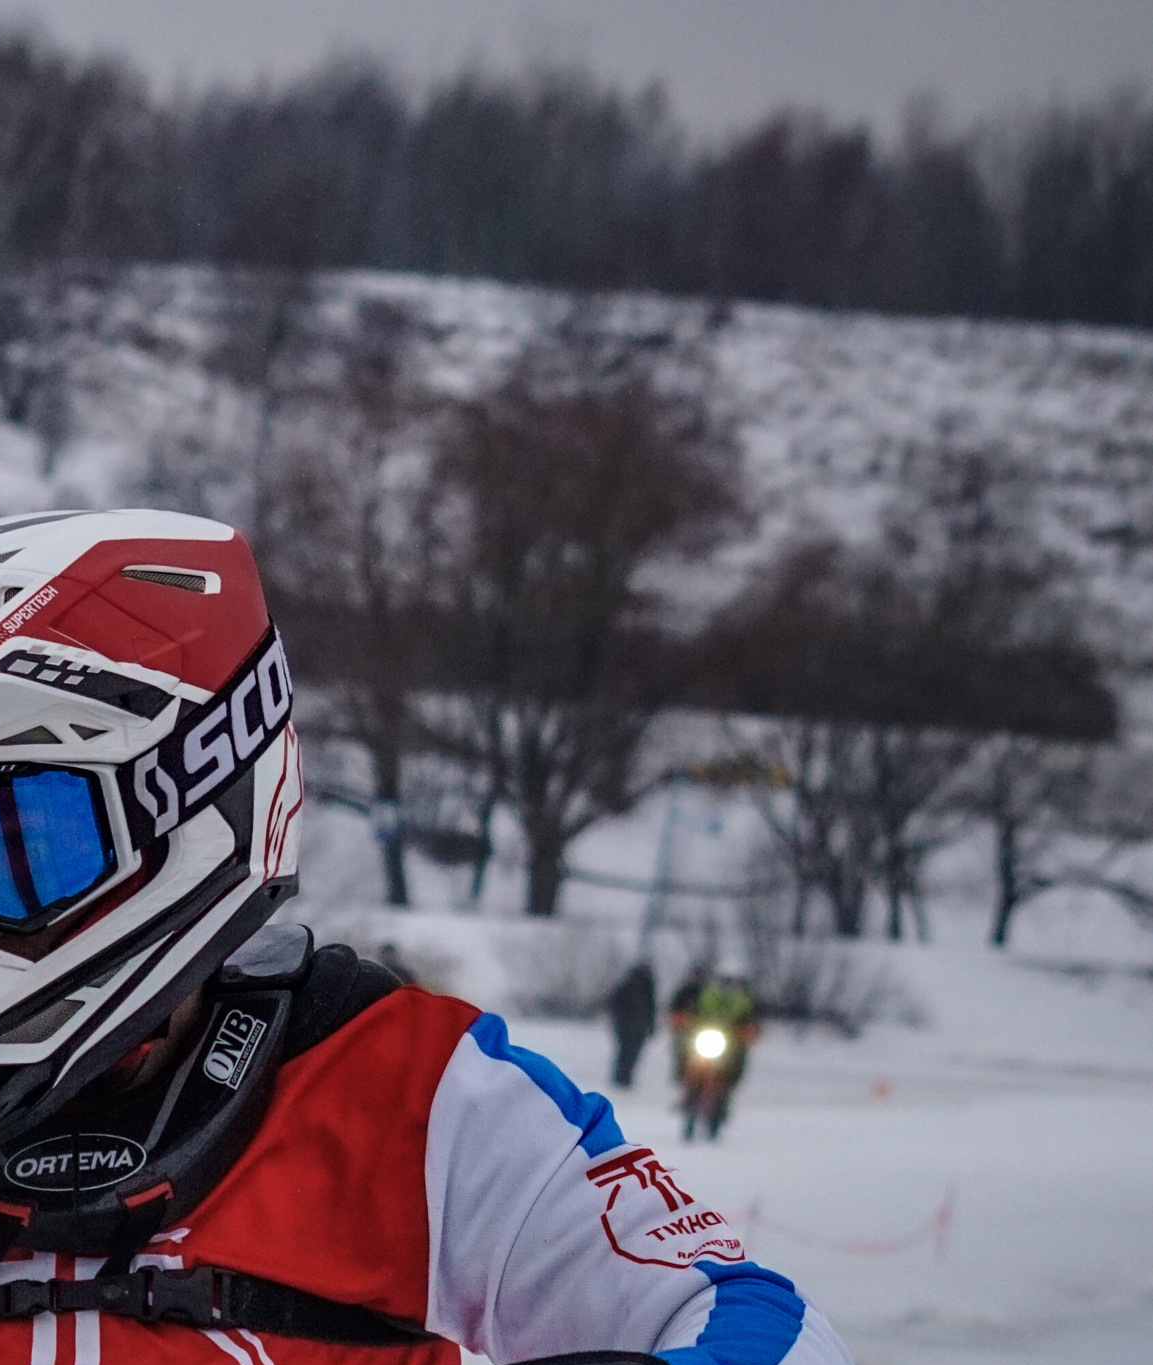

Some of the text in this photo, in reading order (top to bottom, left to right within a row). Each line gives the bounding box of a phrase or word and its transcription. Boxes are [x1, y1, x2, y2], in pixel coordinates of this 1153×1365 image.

[2, 584, 59, 634] SUPERTECH
[15, 1146, 134, 1178] ORTEMA
[645, 1211, 729, 1242] TIKHO
